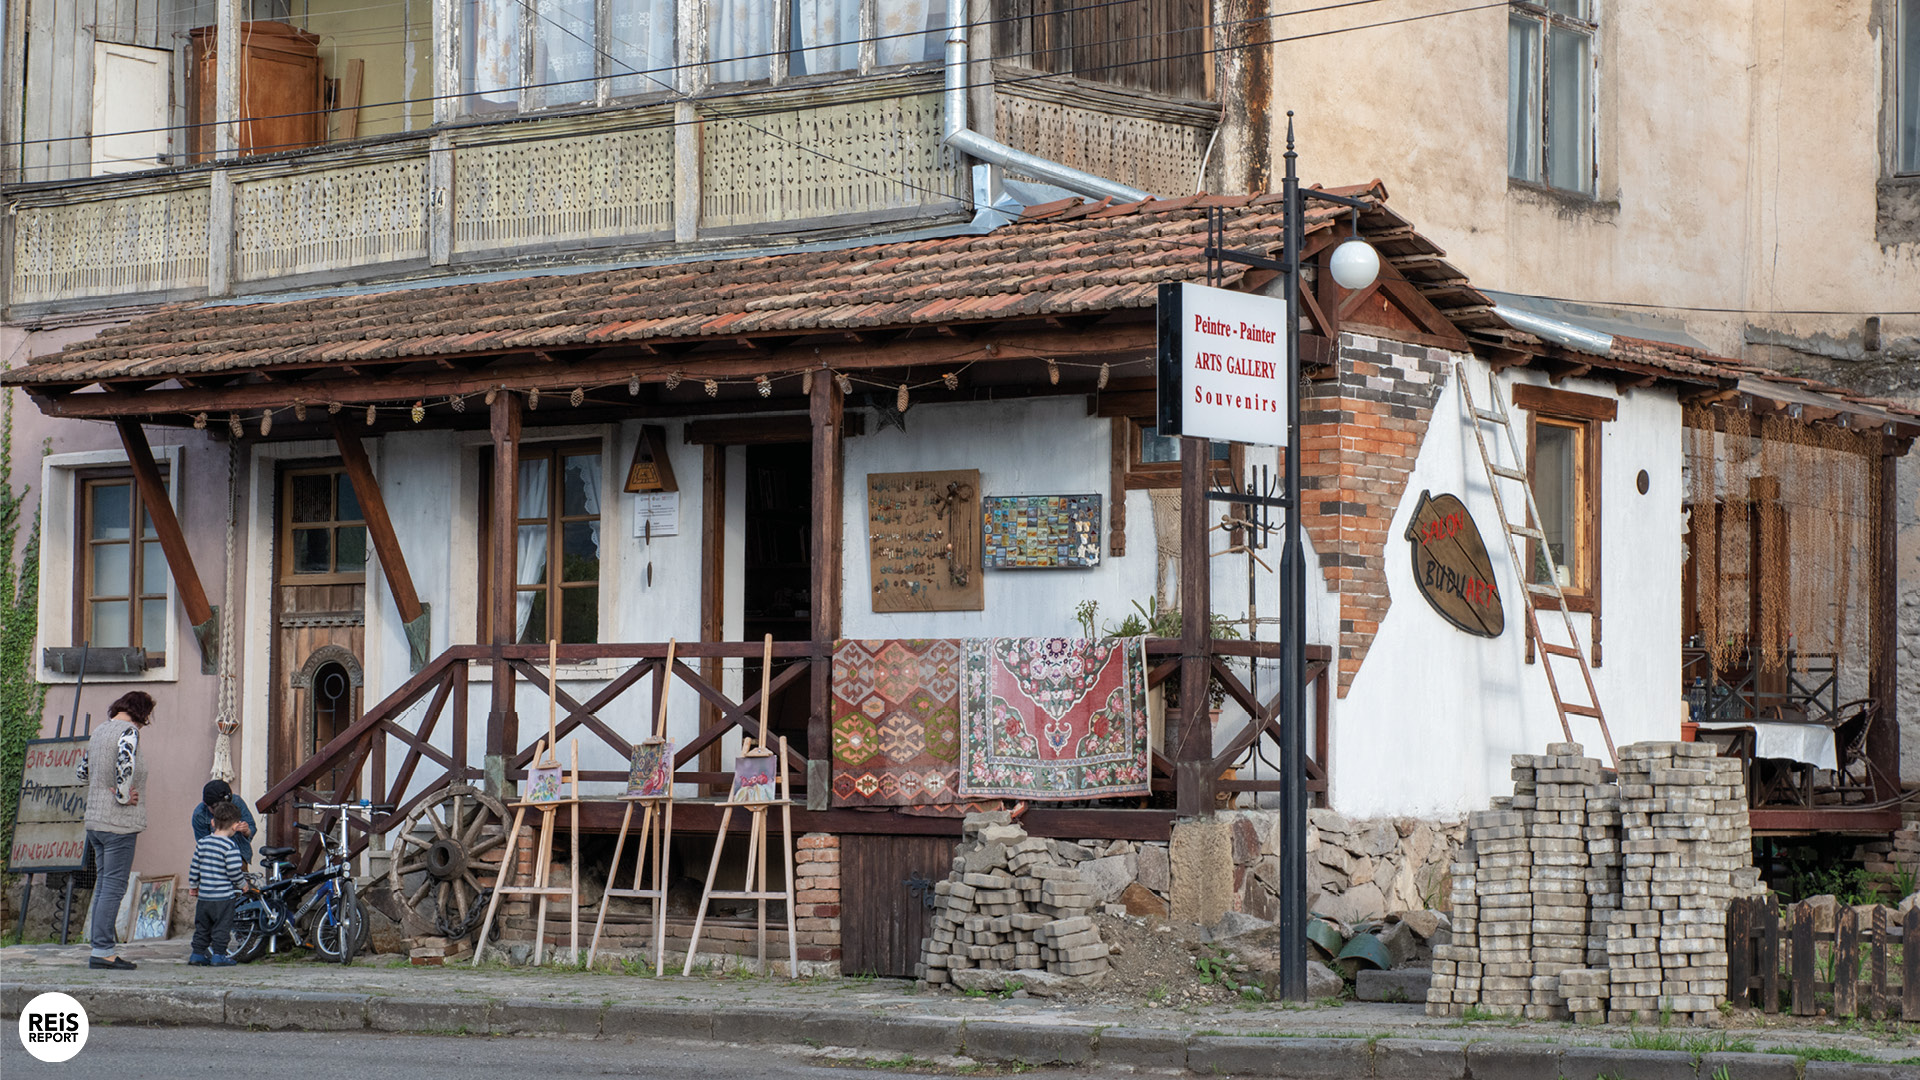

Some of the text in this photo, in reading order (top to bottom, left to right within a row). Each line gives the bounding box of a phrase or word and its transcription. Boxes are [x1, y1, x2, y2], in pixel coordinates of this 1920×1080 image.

[1194, 314, 1231, 338] Peintre
[1240, 322, 1277, 344] Painter
[1194, 352, 1277, 380] ARTS GALLERY
[1195, 385, 1277, 413] Souvenirs
[1421, 510, 1464, 546] SALON
